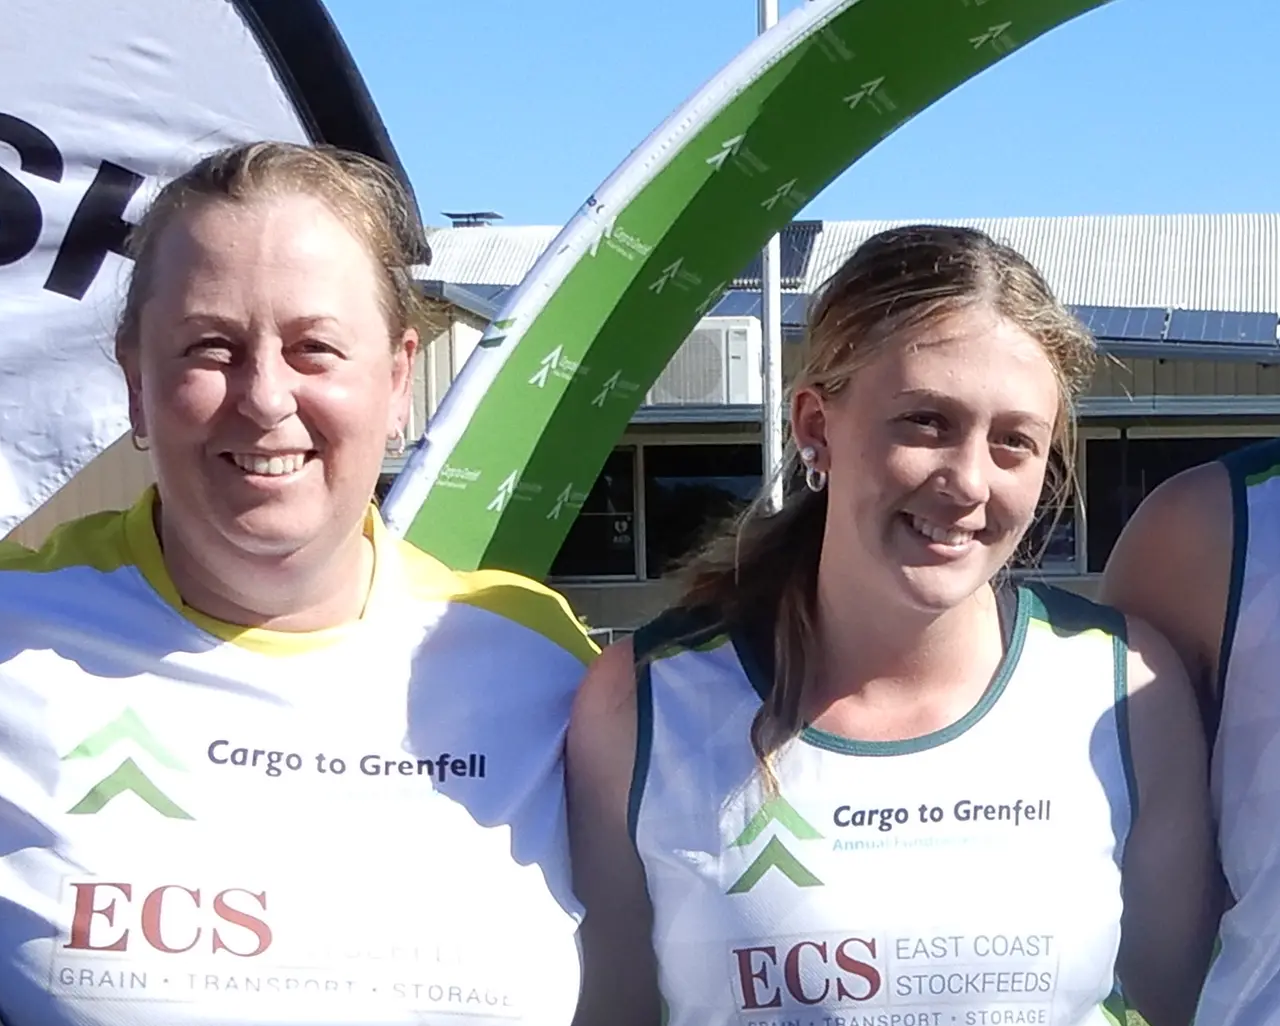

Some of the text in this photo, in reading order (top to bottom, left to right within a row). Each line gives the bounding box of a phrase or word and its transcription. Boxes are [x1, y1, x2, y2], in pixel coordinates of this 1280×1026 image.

[208, 740, 486, 782] Cargo to Grenfell
[833, 799, 1051, 831] Cargo to Grenfell
[64, 882, 273, 957] ECS
[59, 967, 147, 990] GRAIN
[732, 934, 1054, 1010] ECS EAST COAST
[895, 972, 1051, 997] STOCKFEEDS
[965, 1010, 1045, 1026] STORAGE
